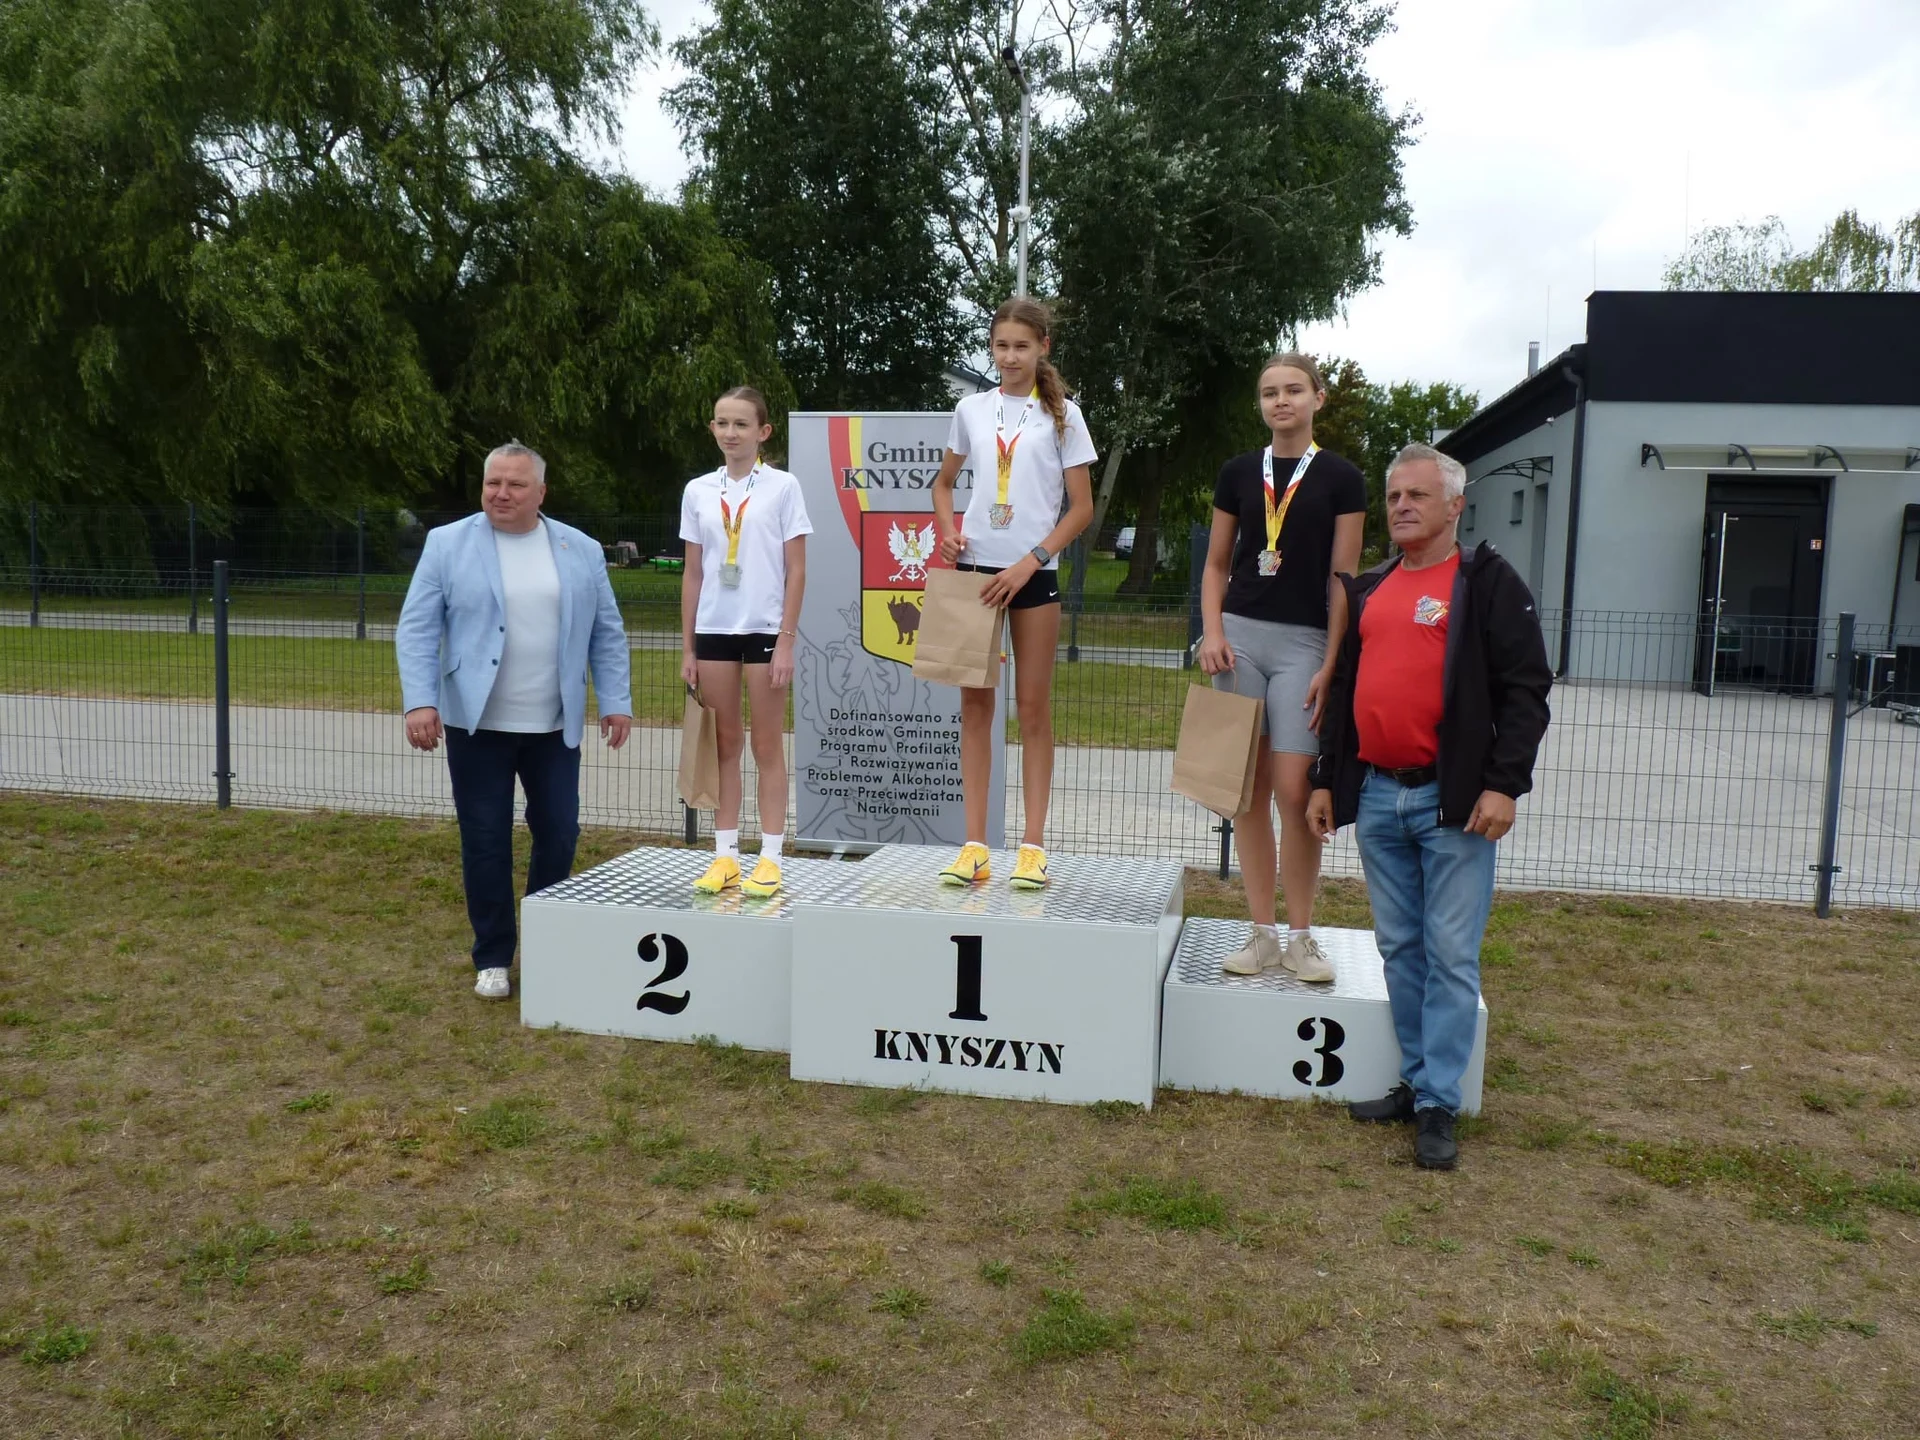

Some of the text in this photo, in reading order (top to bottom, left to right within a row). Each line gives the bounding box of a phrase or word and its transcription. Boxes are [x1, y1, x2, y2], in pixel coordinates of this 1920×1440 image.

[868, 441, 944, 463] Gmin
[830, 708, 942, 723] Dofinansowano
[893, 726, 960, 742] Gminneg
[820, 738, 961, 759] Programu Profilakty
[838, 755, 842, 767] i
[808, 769, 963, 786] Problemów Alkoholow
[819, 786, 964, 802] oraz Przeciwdziałan
[857, 801, 940, 817] Narkomanii
[637, 933, 691, 1015] 2
[949, 935, 988, 1021] 1
[874, 1029, 1064, 1075] KNYSZYN
[1293, 1017, 1345, 1087] 3
